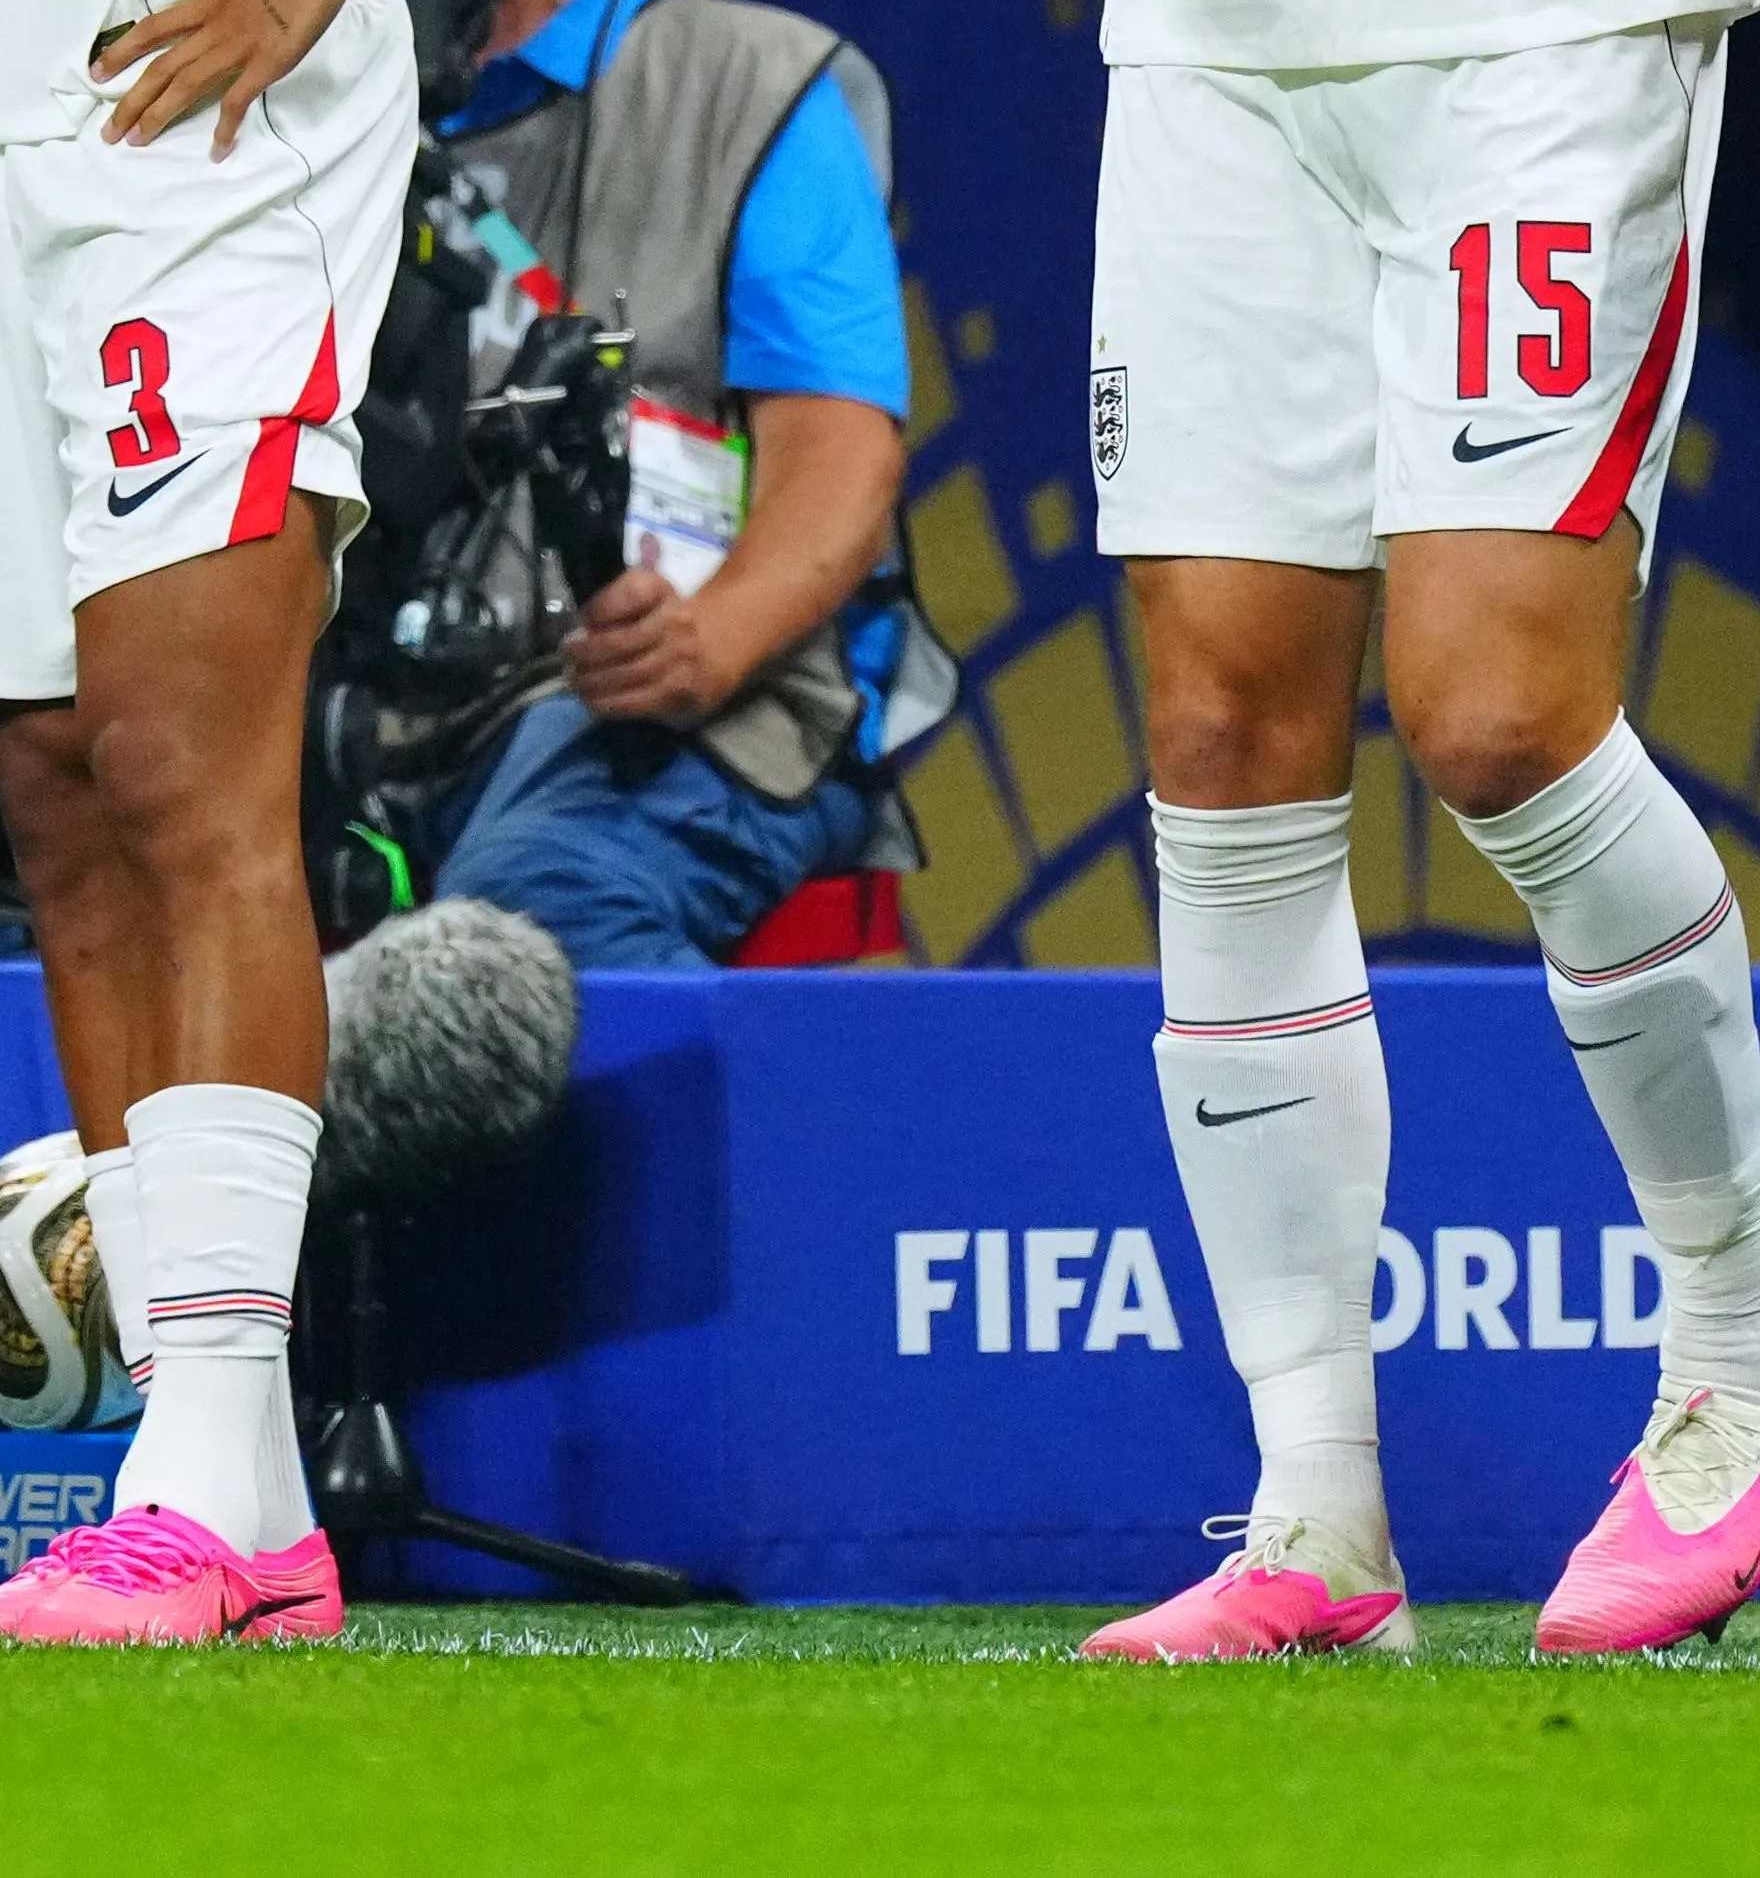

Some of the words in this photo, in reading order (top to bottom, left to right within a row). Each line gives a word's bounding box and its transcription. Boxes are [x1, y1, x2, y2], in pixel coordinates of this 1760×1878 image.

[1449, 220, 1592, 400] 15
[99, 316, 182, 468] 3
[894, 1227, 1182, 1356] FIFA
[1369, 1225, 1671, 1353] ORLD
